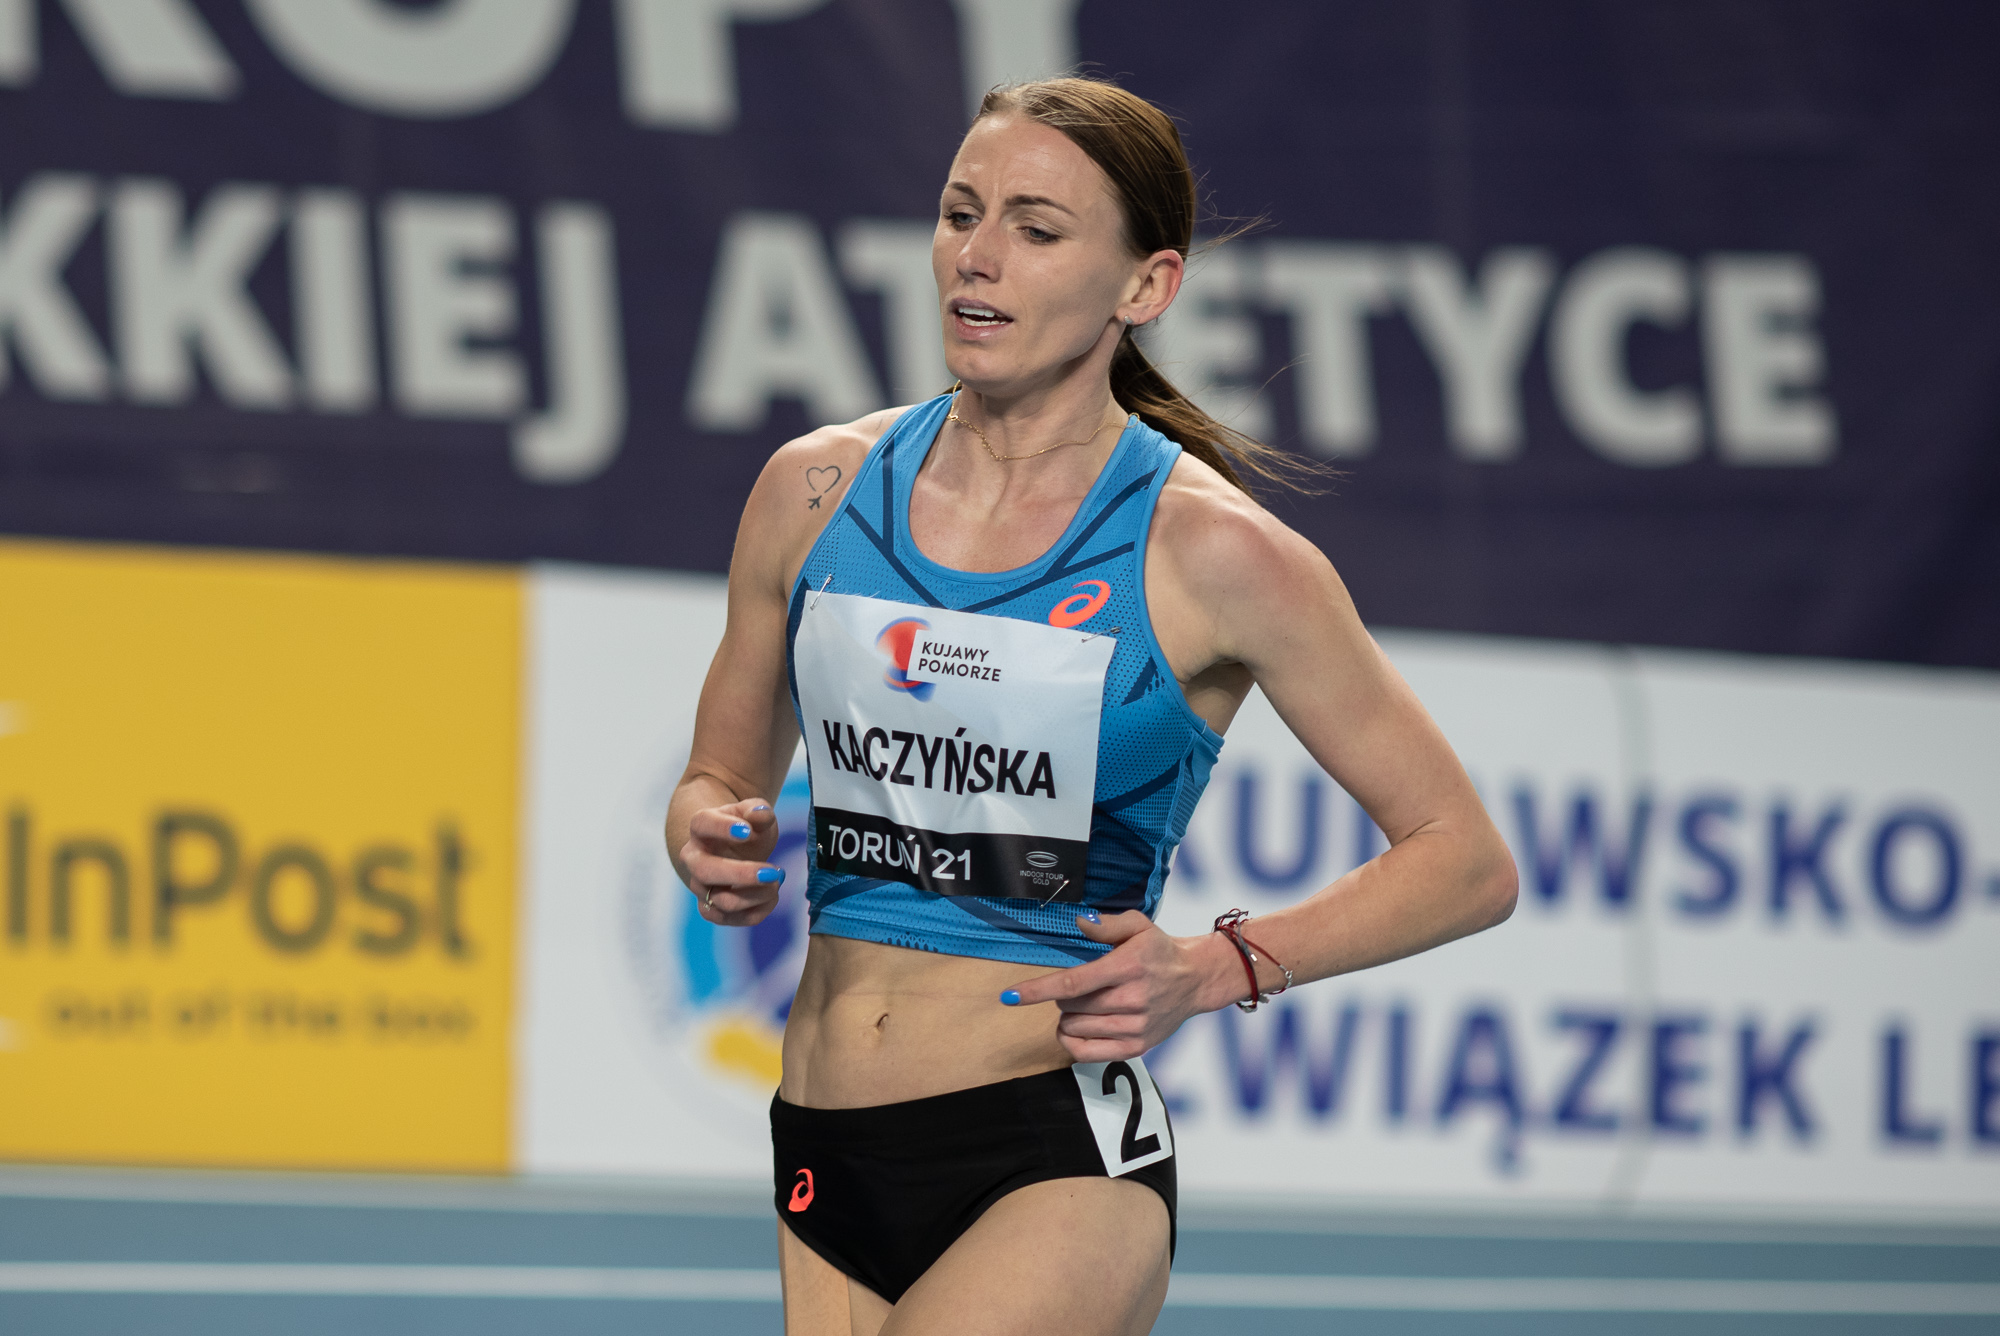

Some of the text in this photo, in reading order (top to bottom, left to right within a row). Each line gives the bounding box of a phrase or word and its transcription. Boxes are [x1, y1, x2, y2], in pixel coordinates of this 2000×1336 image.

[691, 214, 1836, 465] ATETYCE
[917, 658, 1002, 683] POMORZE
[920, 641, 990, 664] KUJAWY
[822, 719, 1057, 799] KACZYŃSKA
[828, 823, 972, 881] TORUŃ 21
[1019, 870, 1044, 879] INDOOR
[1045, 872, 1065, 881] TOUR
[4, 805, 474, 962] InPost
[1032, 877, 1050, 886] GOLD
[1101, 1060, 1162, 1165] 2
